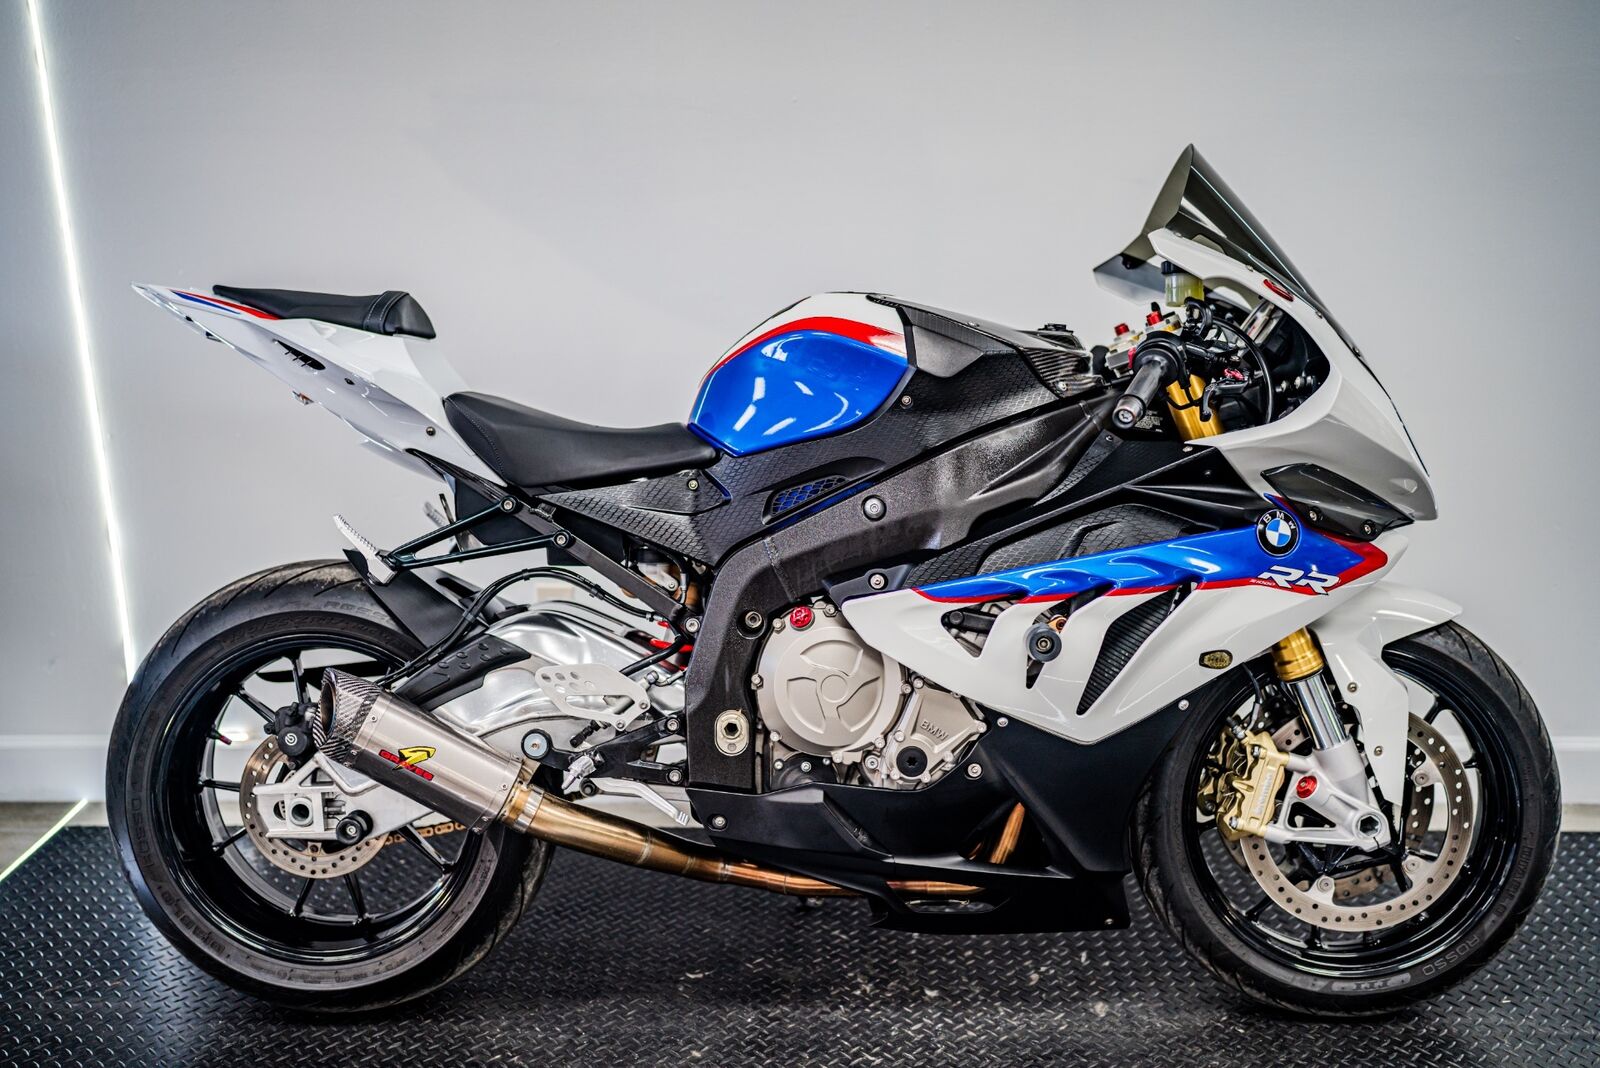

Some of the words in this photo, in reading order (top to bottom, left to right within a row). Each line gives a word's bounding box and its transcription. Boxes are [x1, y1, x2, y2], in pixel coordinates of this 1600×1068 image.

[1257, 565, 1339, 595] RR
[920, 720, 949, 741] BMW
[1422, 934, 1480, 976] ROSSO
